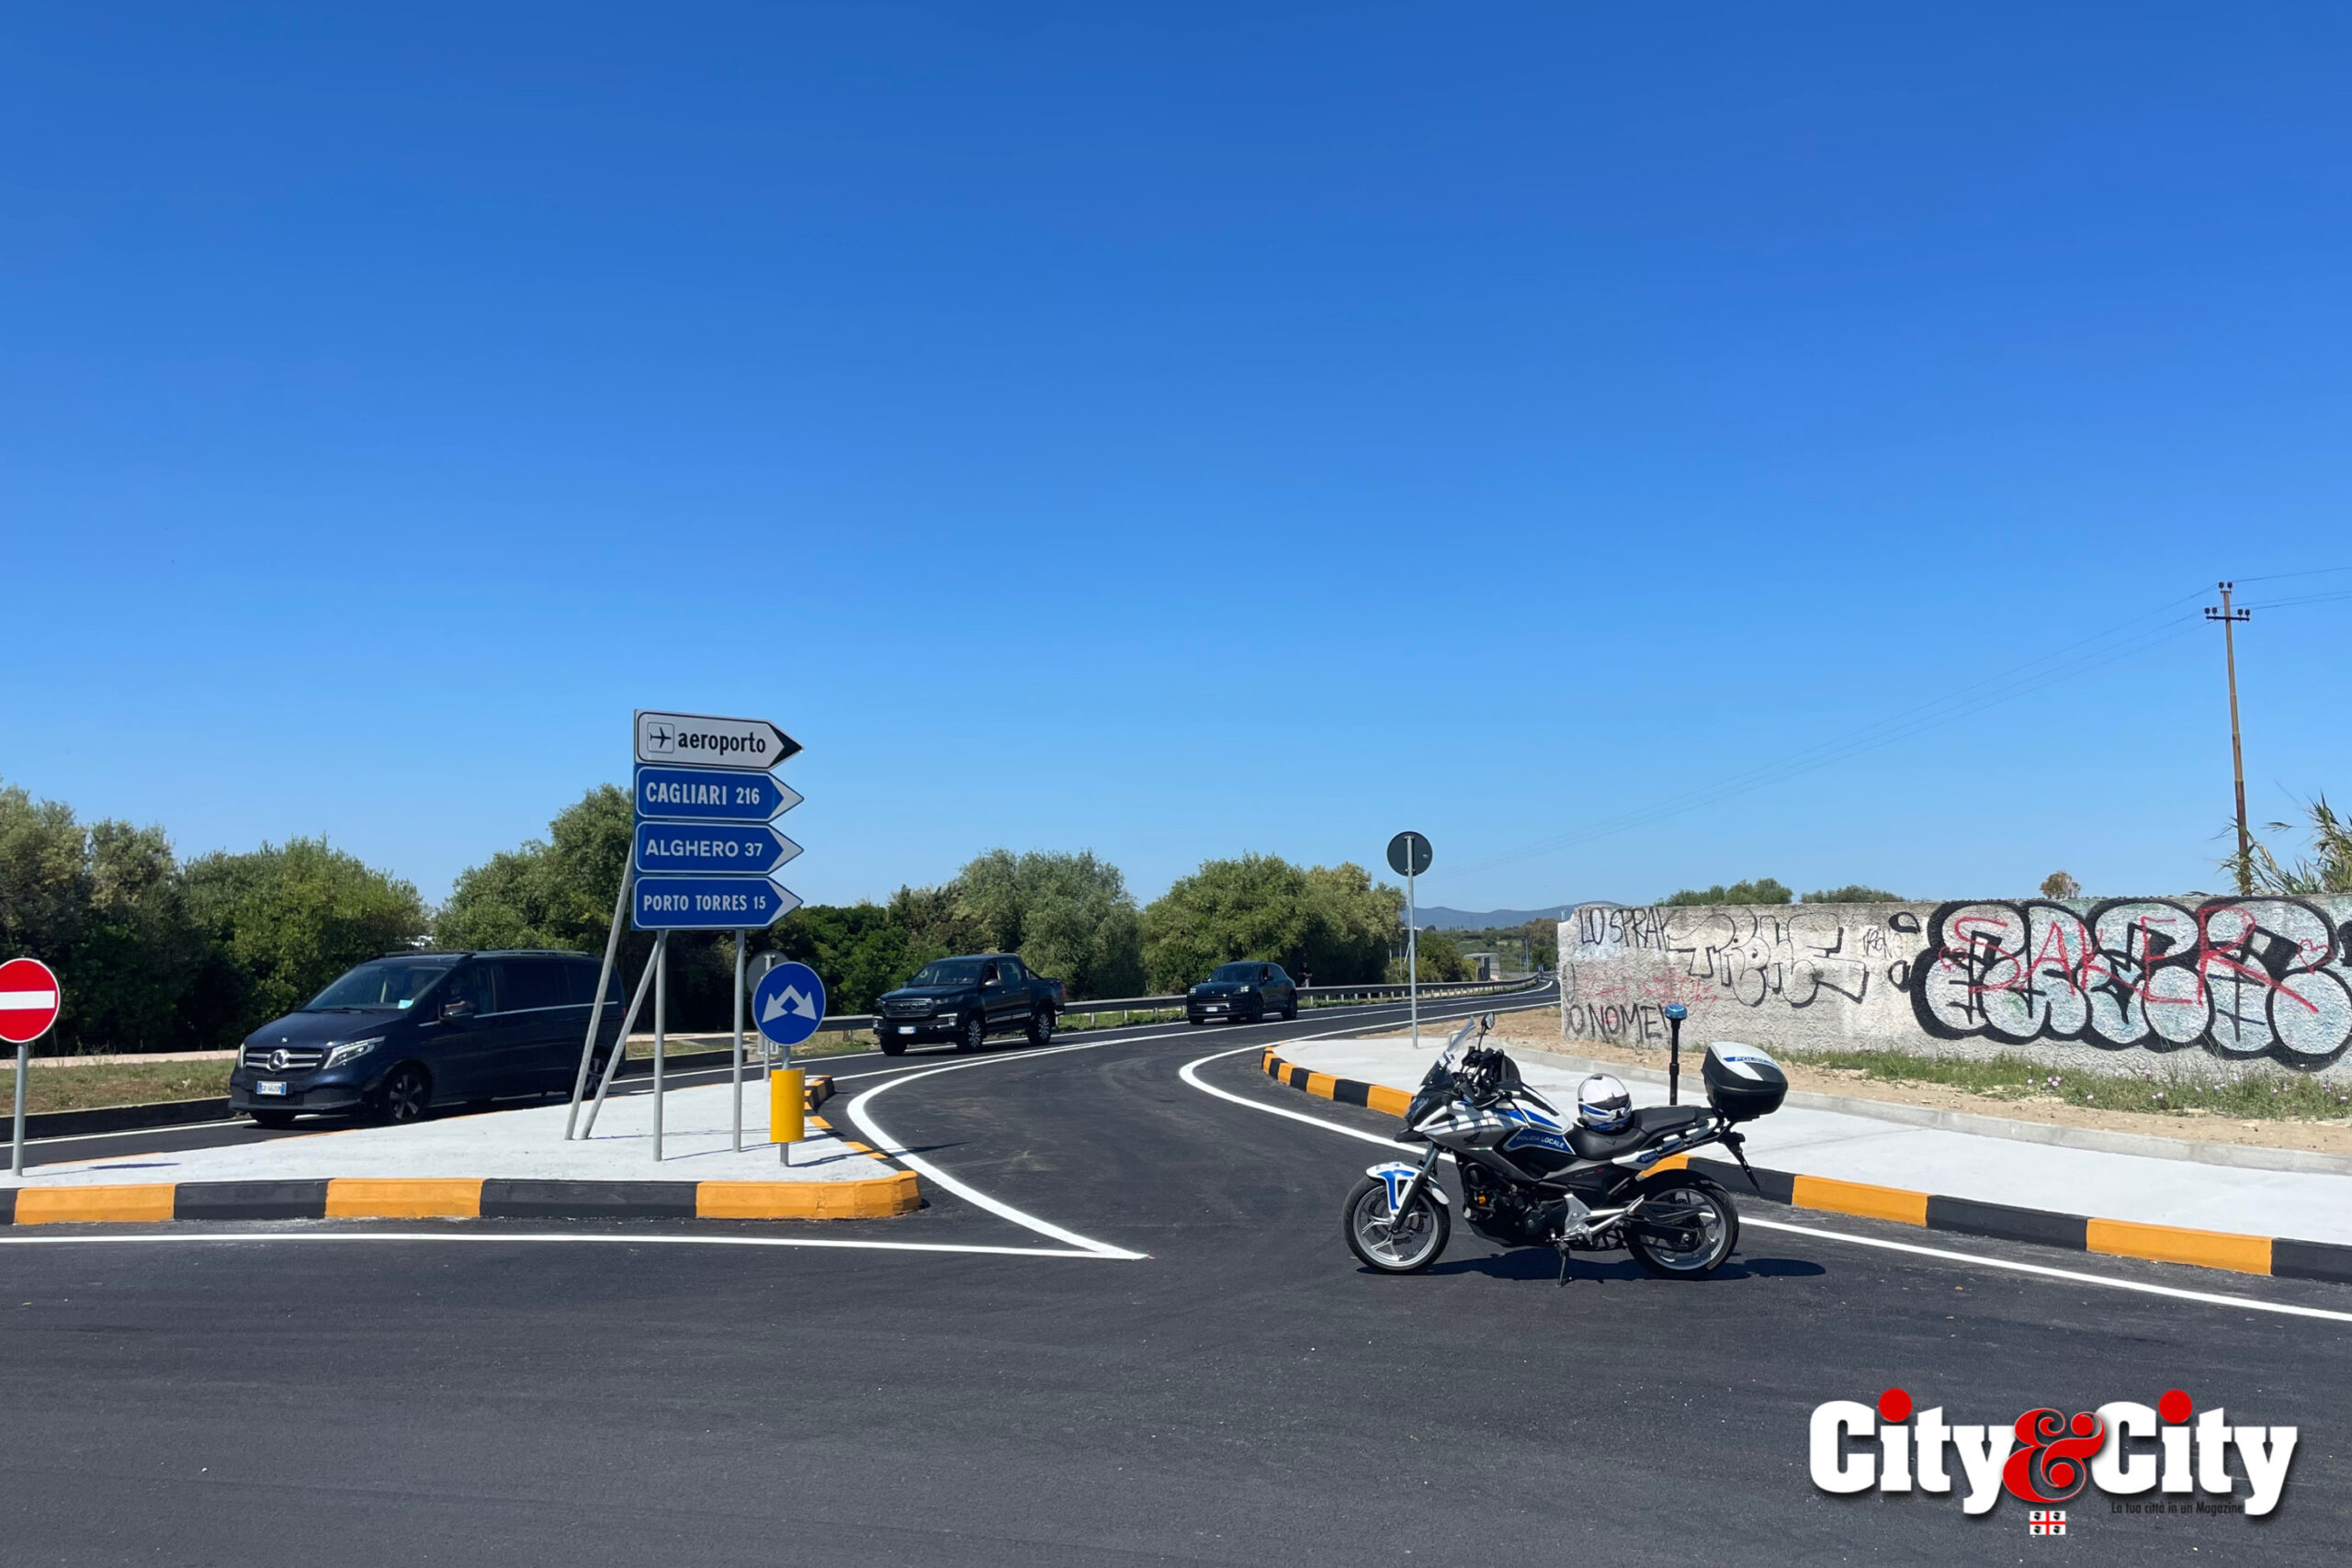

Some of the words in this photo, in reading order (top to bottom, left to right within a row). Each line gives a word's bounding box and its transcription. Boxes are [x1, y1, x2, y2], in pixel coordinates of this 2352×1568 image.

[678, 732, 766, 755] aeroporto
[646, 782, 727, 806] CAGLIARI
[736, 787, 761, 805] 216
[645, 840, 739, 857] ALGHERO
[744, 842, 763, 857] 37
[644, 895, 689, 911] PORTO
[695, 895, 748, 911] TORRES
[753, 896, 766, 909] 15
[1579, 907, 1605, 945] LO
[1610, 907, 1678, 953] SPRAY
[1541, 1135, 1566, 1149] LOCALE
